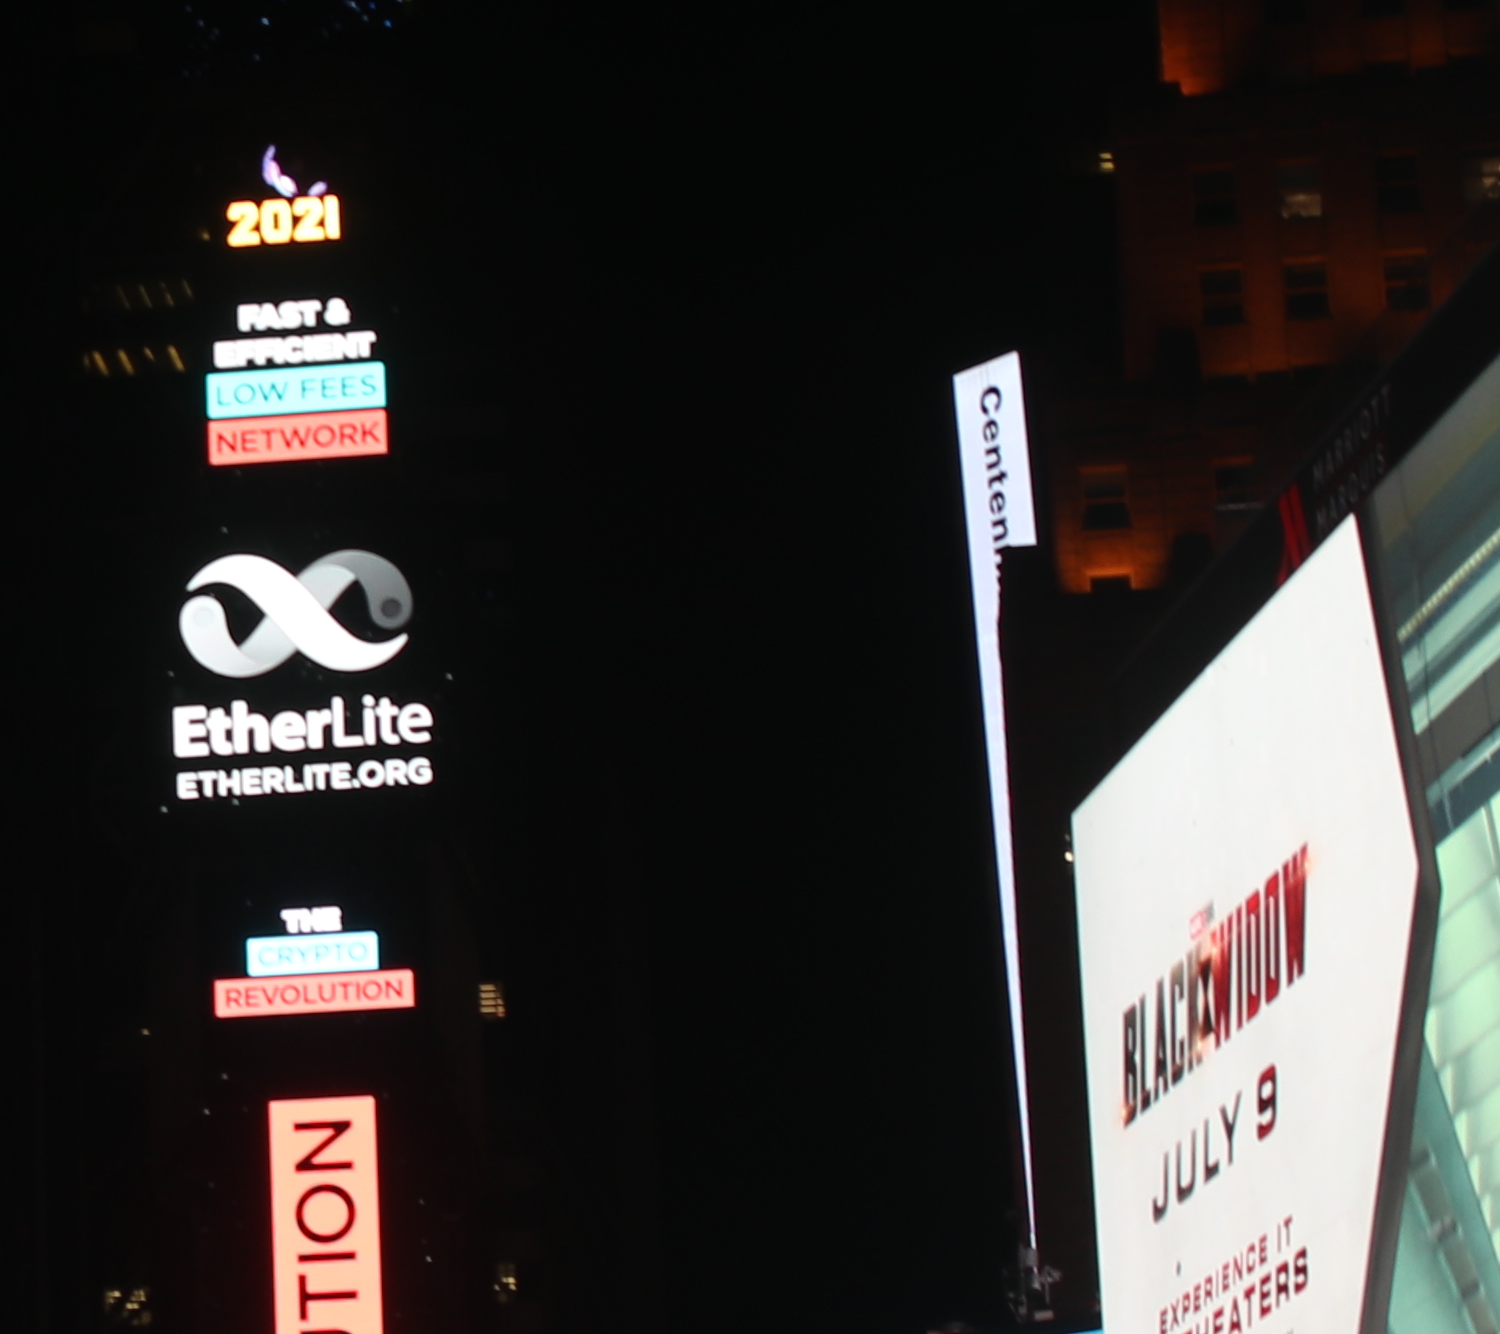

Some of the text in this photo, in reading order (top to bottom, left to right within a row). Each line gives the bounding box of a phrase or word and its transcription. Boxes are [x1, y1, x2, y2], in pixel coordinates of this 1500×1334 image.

[226, 194, 341, 247] 2021
[237, 298, 352, 333] FAST &
[213, 331, 378, 369] EFFICIENT
[215, 373, 379, 408] LOW FEES
[215, 421, 382, 454] NETWORK
[171, 694, 434, 758] EtherLite
[176, 757, 434, 800] ETHERLITE.ORG
[280, 906, 343, 934] THE
[256, 939, 368, 969] CRYPTO
[224, 978, 405, 1010] REVOLUTION
[1121, 843, 1310, 1129] BLACK WIDOW
[1153, 1062, 1279, 1225] JULY 9
[1275, 1215, 1295, 1254] IT
